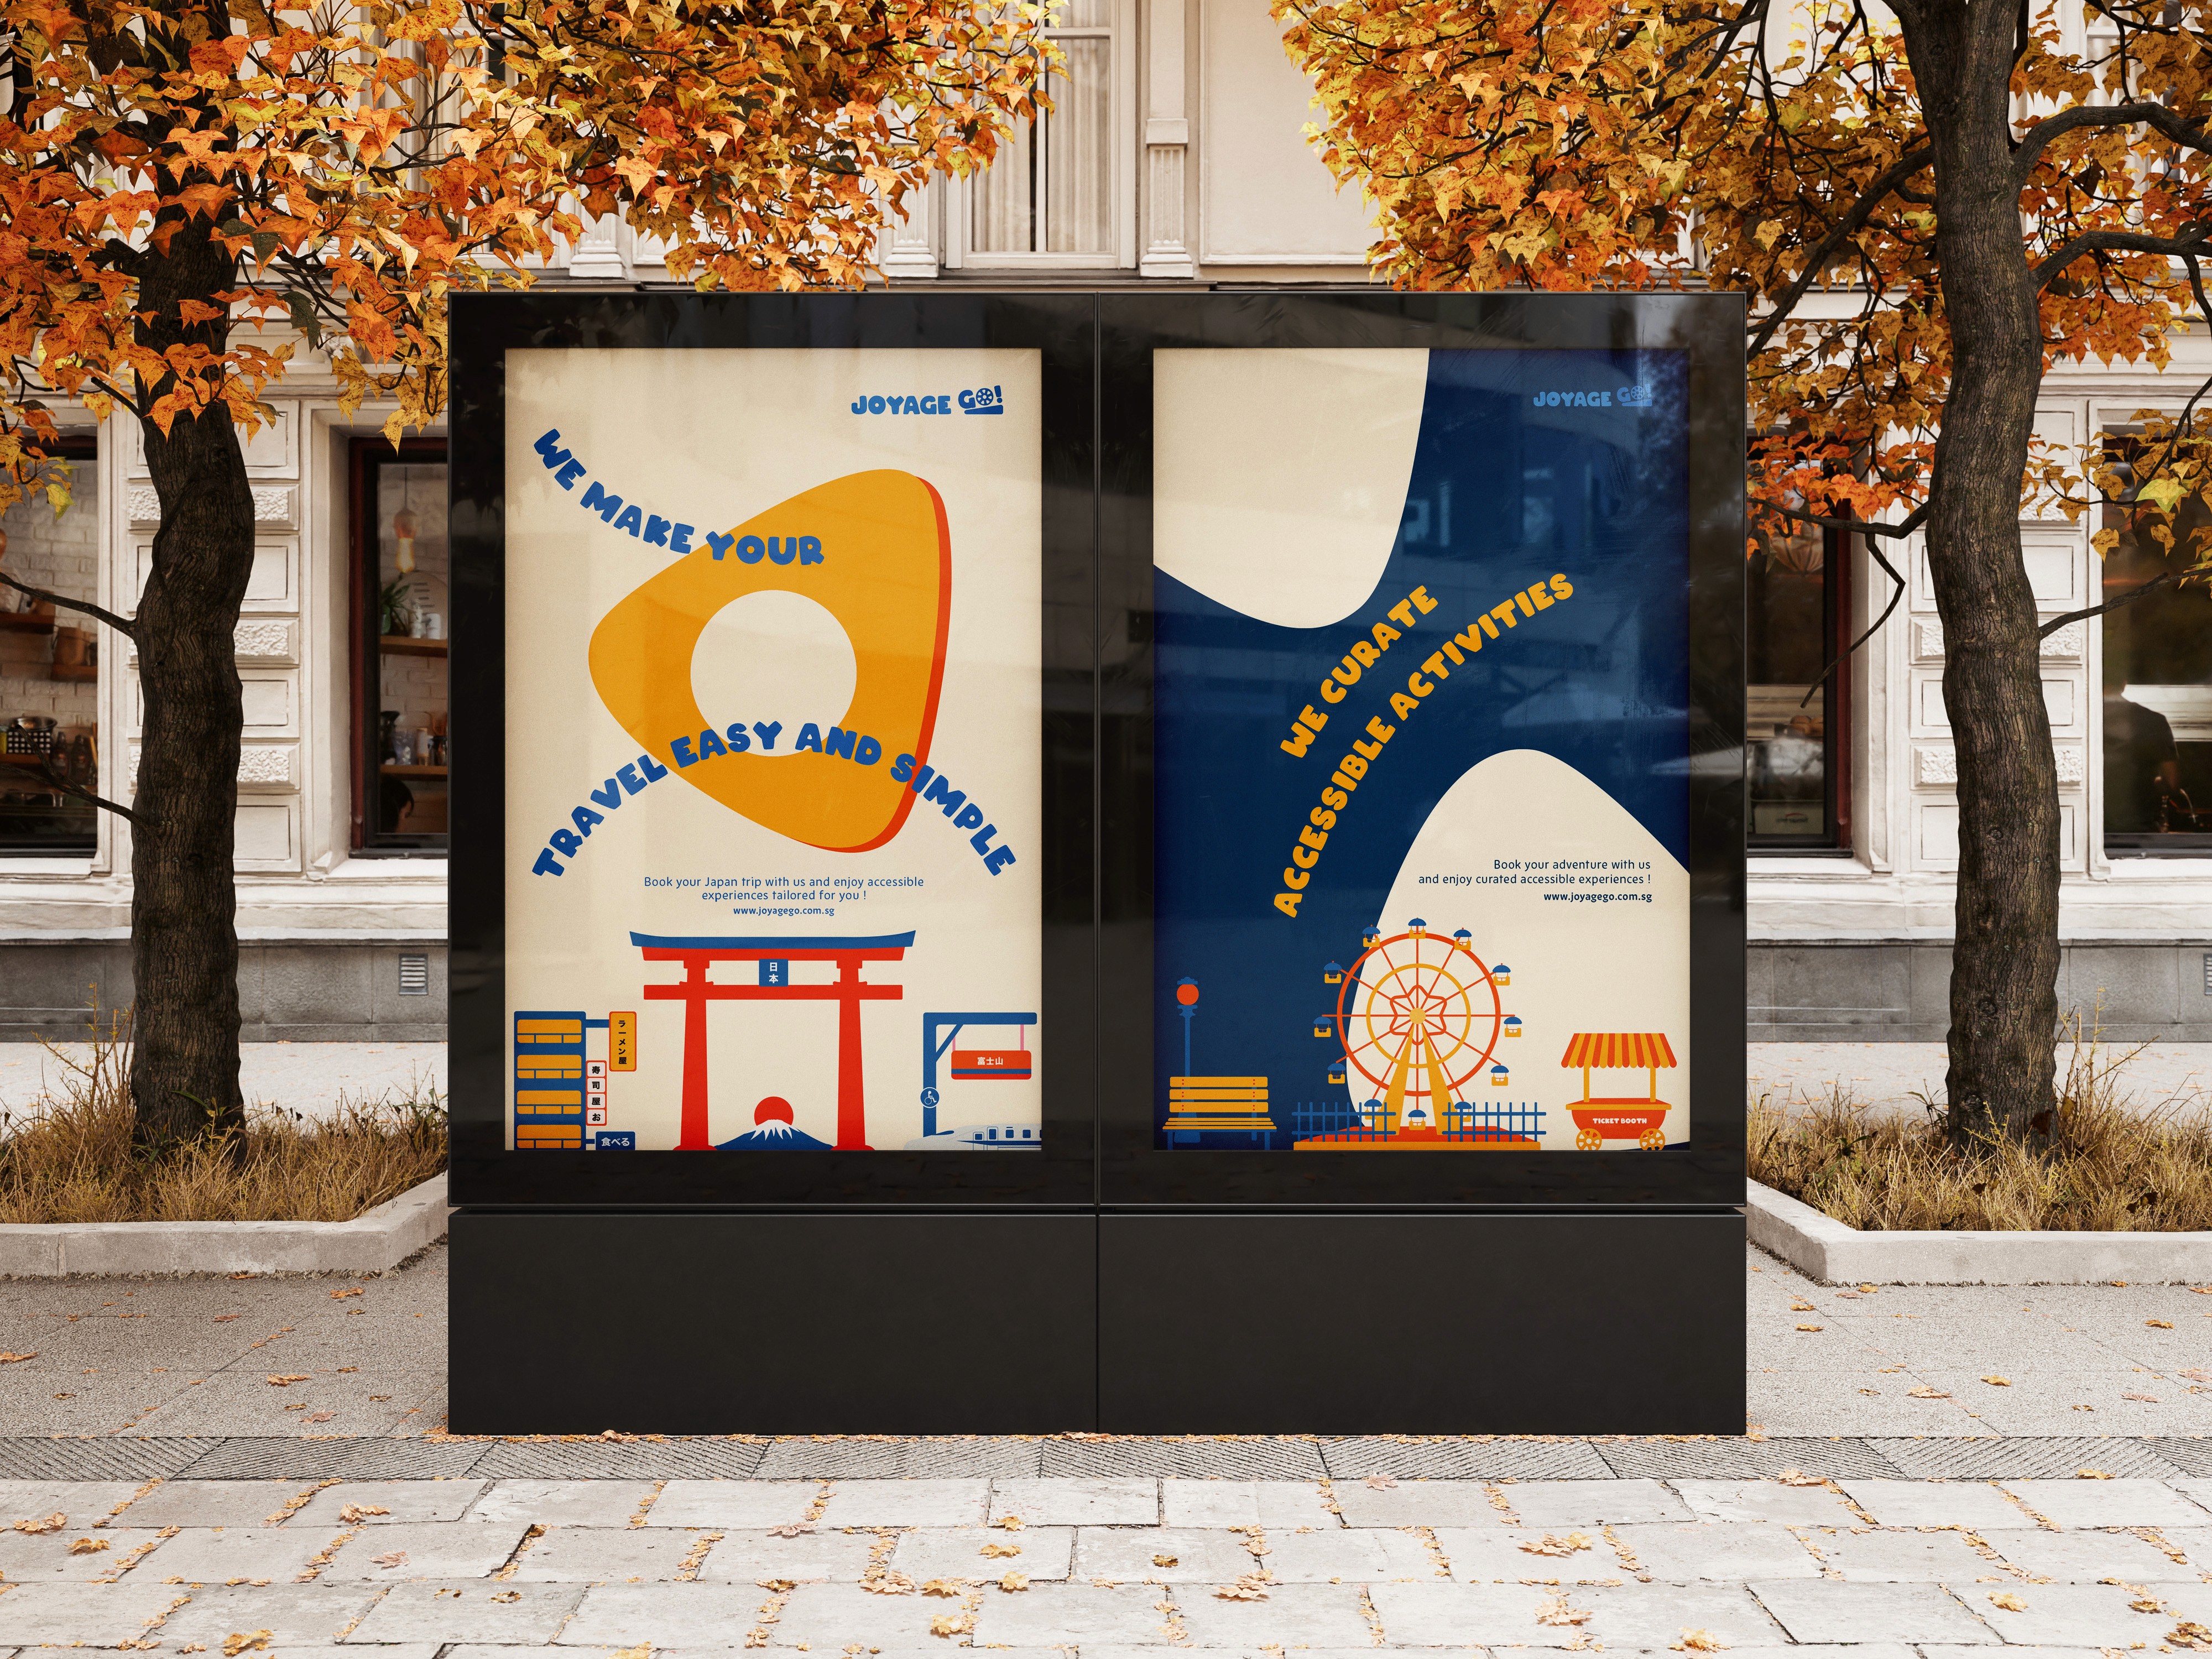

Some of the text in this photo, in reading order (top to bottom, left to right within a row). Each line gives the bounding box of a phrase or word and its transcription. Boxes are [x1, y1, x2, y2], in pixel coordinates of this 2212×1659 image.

[851, 385, 1002, 415] JOYAGE GO!
[1533, 391, 1612, 407] JOYAGE
[533, 428, 825, 565] WE MAKE YOUR
[1280, 585, 1438, 758] WE CURATE
[1274, 573, 1574, 918] ACCESSIBLE ACTIVITIES
[531, 721, 1016, 877] TRAVEL EASY AND SIMPLE
[1494, 859, 1651, 872] Book your adventure with us
[644, 877, 924, 889] Book your Japan trip with us and enjoy accessible
[1418, 874, 1651, 886] and enjoy curated accessible experiences !
[702, 890, 867, 902] experiences tailored for you !
[1543, 892, 1652, 903] www.joyagego.com.sg
[733, 906, 835, 916] www.joyagego.com.sg
[769, 962, 779, 984] 日本
[618, 1019, 627, 1065] ラーメン屋
[977, 1056, 1003, 1066] 富士山
[601, 1137, 630, 1147] 食べる
